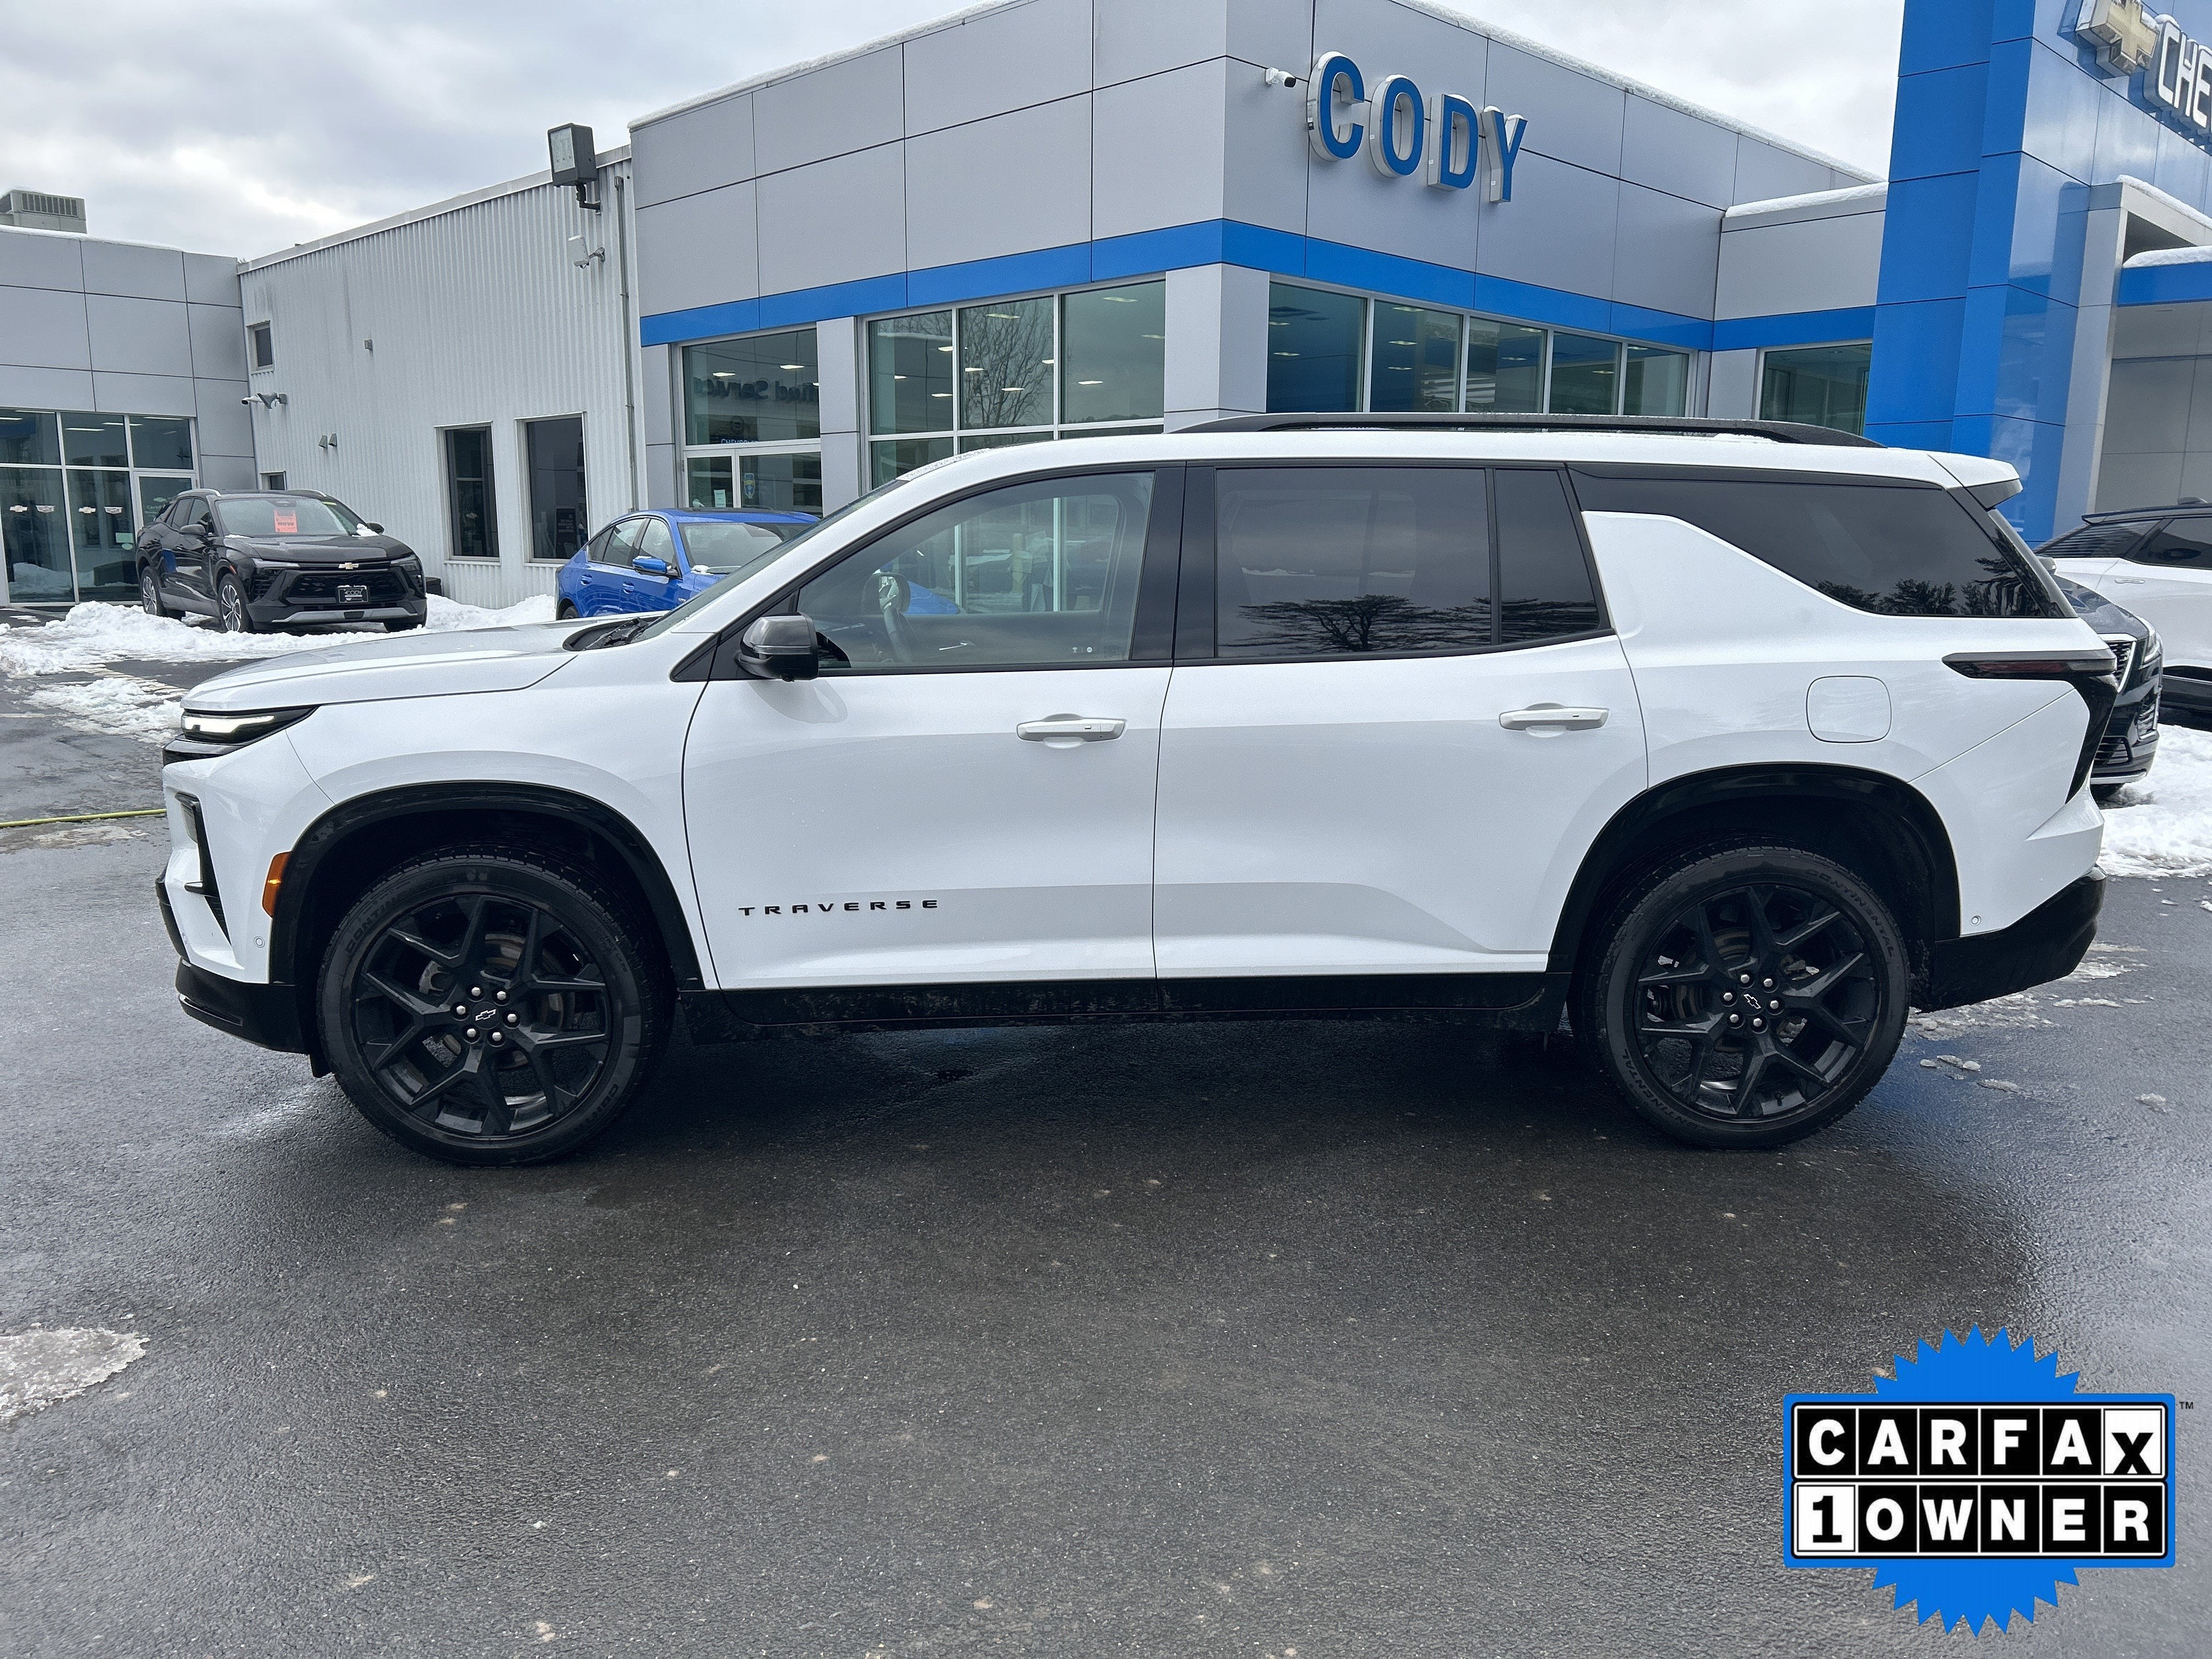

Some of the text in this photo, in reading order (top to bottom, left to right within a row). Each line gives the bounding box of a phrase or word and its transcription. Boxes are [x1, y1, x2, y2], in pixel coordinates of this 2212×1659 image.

[1311, 55, 1527, 202] CODY
[2158, 20, 2212, 129] CHE
[738, 899, 938, 916] TRAVERSE
